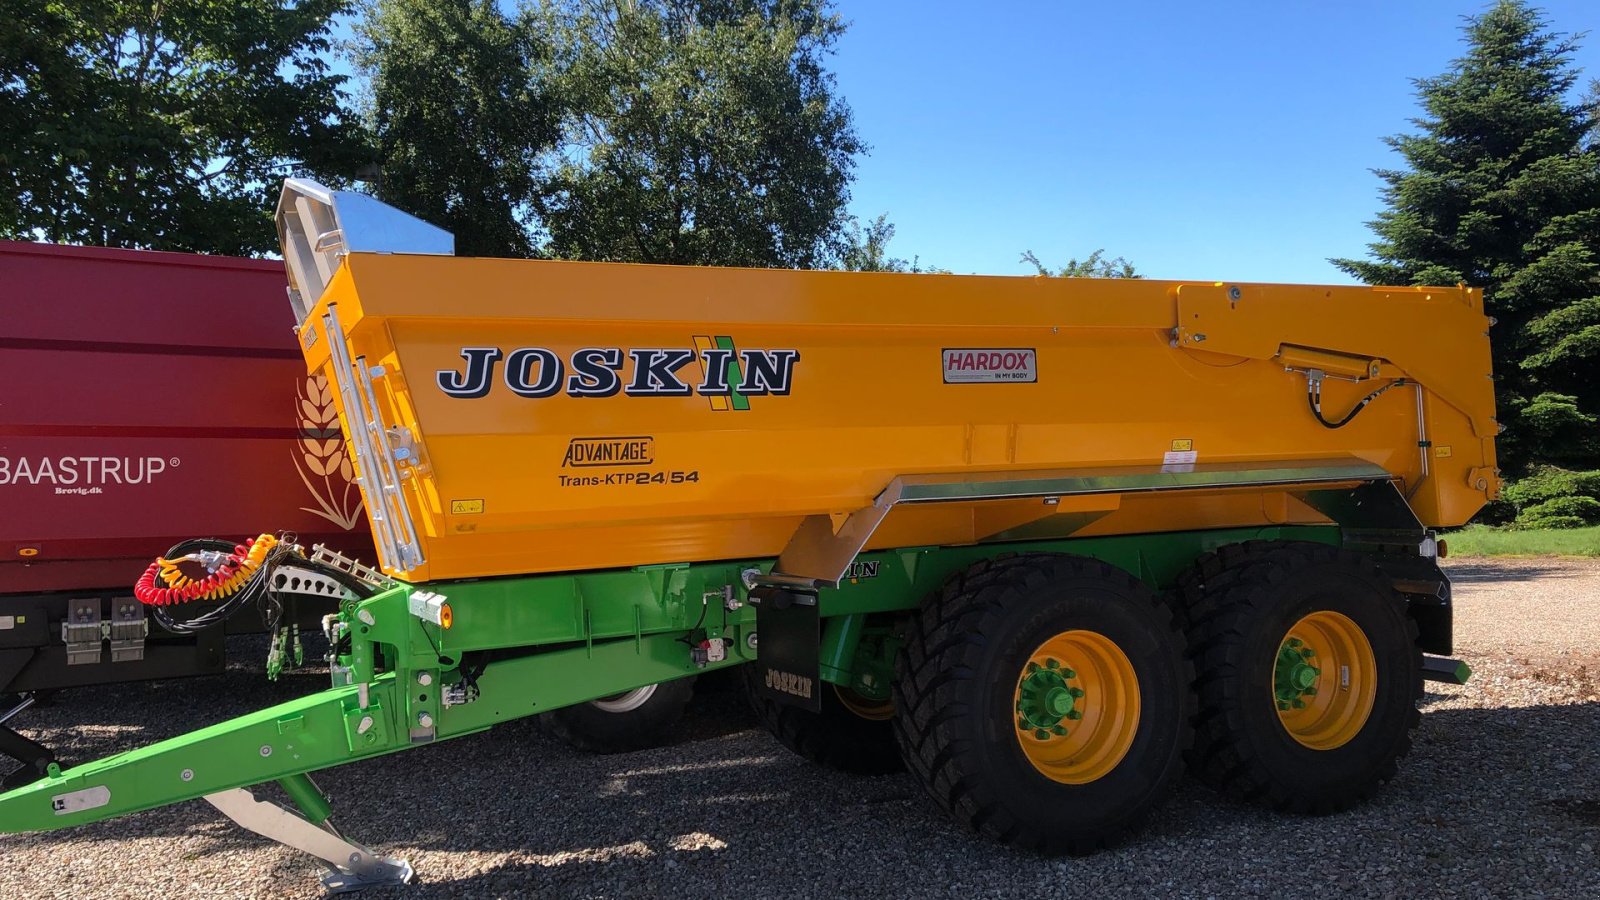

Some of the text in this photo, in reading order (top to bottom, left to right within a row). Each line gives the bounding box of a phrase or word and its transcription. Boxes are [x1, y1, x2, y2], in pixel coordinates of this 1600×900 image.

[436, 347, 800, 398] JOSKIN
[948, 352, 1029, 371] HARDOX
[561, 442, 648, 467] ADVANTAGE
[55, 487, 103, 495] Brovig.dk
[845, 560, 880, 578] IN
[765, 668, 813, 699] JOSKIN
